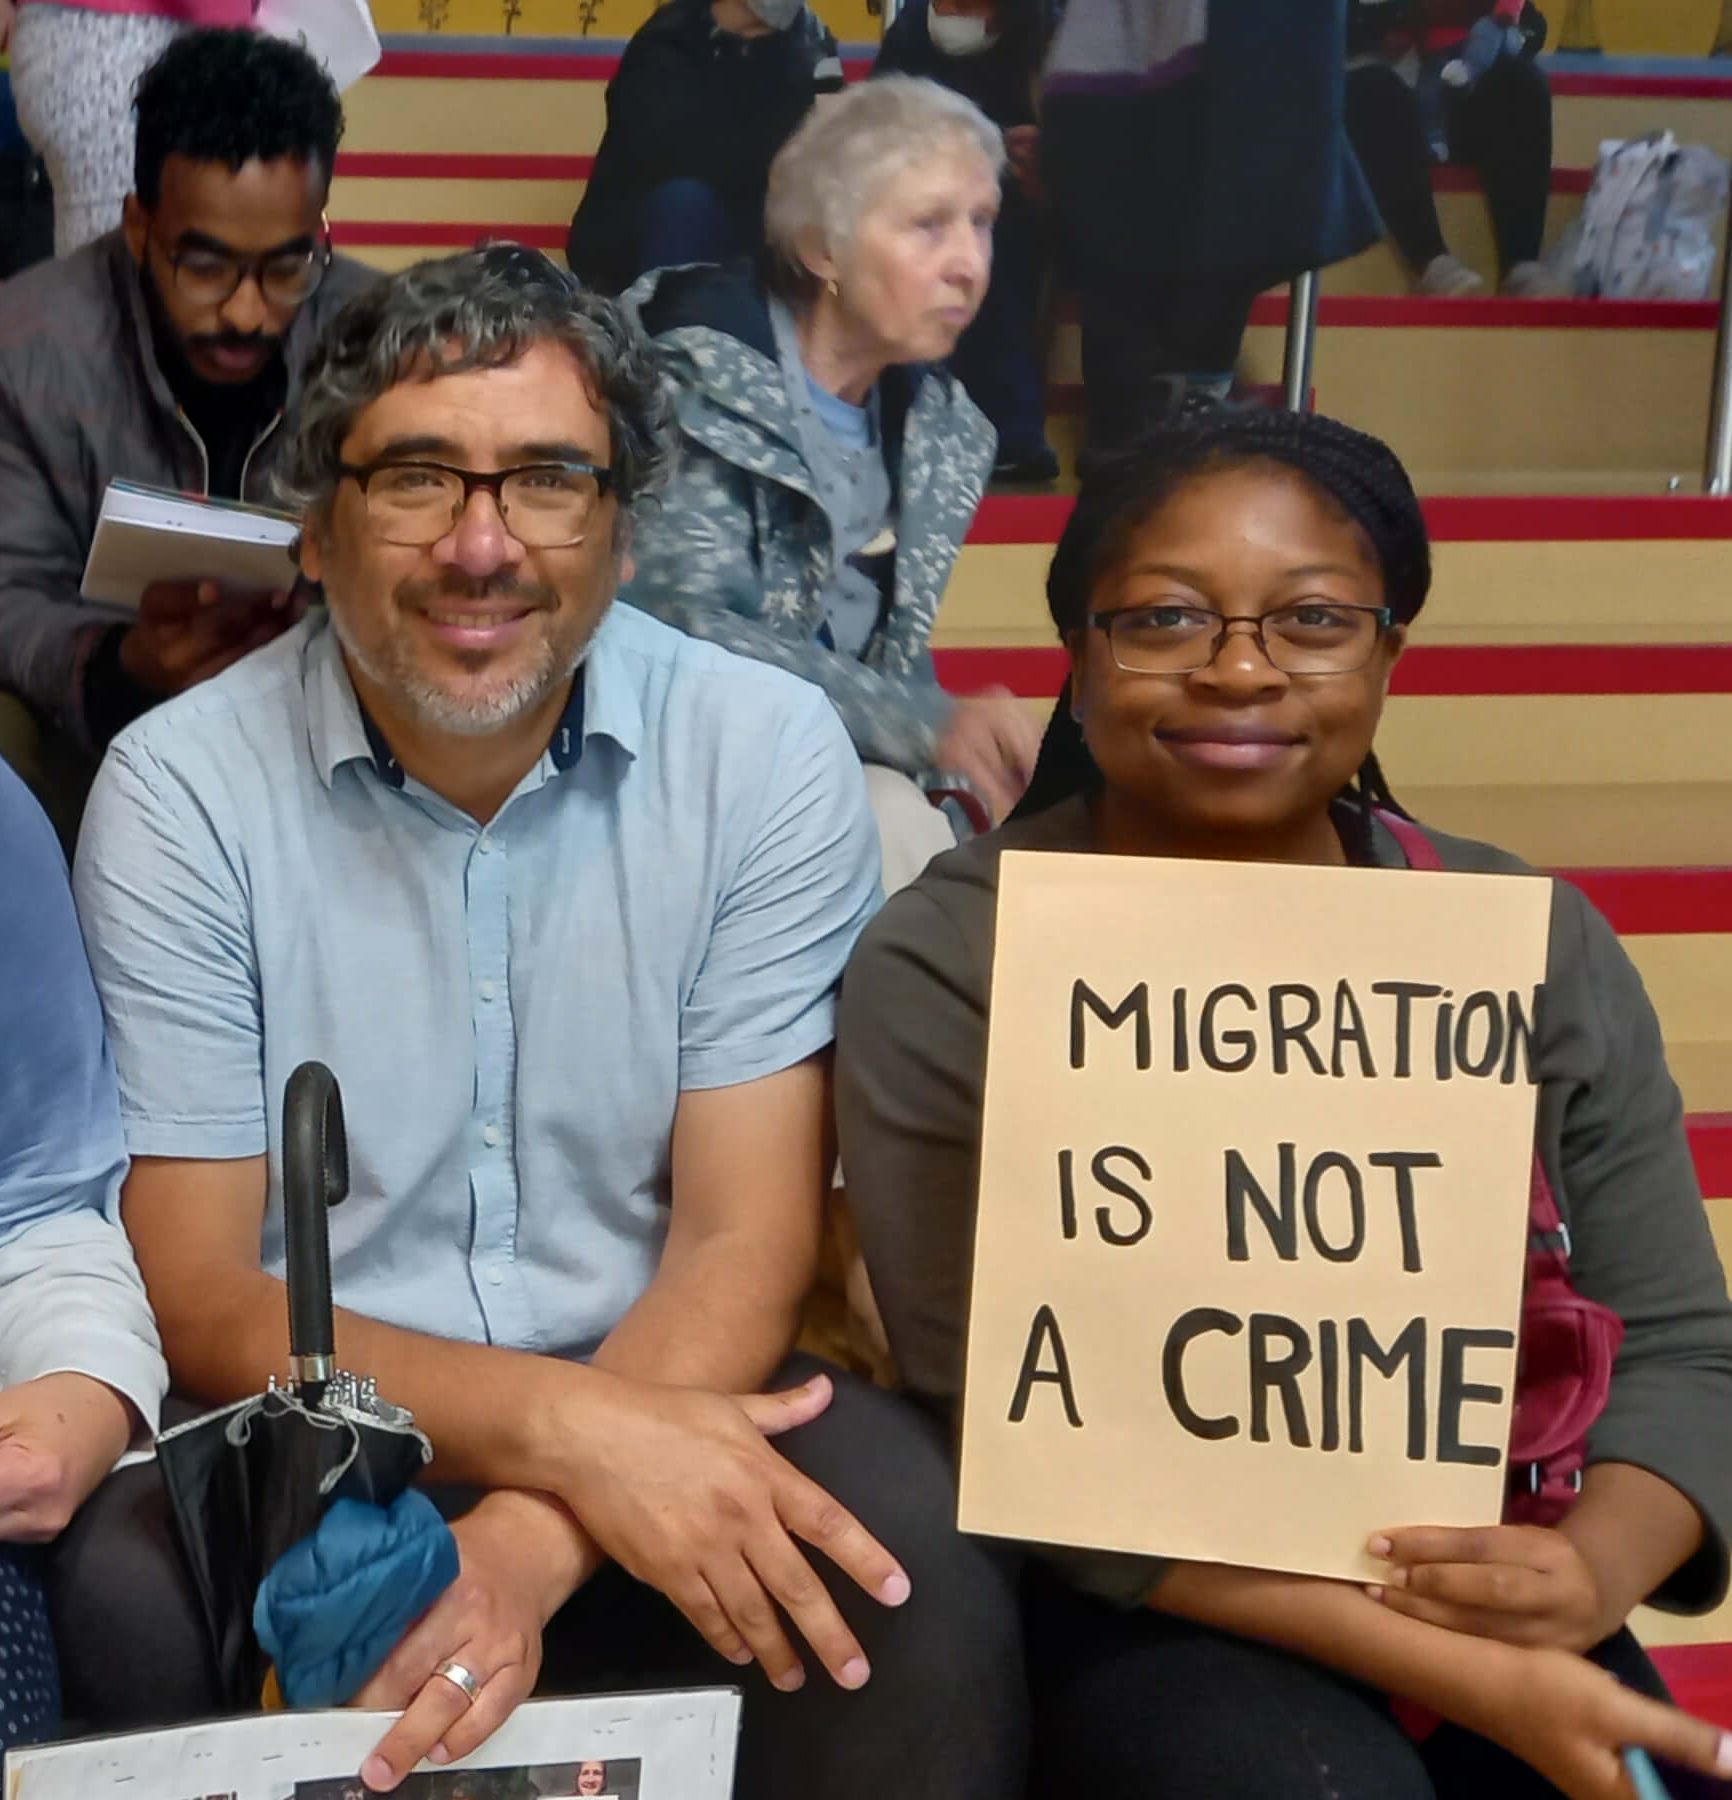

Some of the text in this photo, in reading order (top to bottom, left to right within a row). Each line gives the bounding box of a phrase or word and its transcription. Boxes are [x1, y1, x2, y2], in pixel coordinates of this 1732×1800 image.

[1058, 1142, 1444, 1273] IS NOT
[1008, 1304, 1517, 1467] A CRIME
